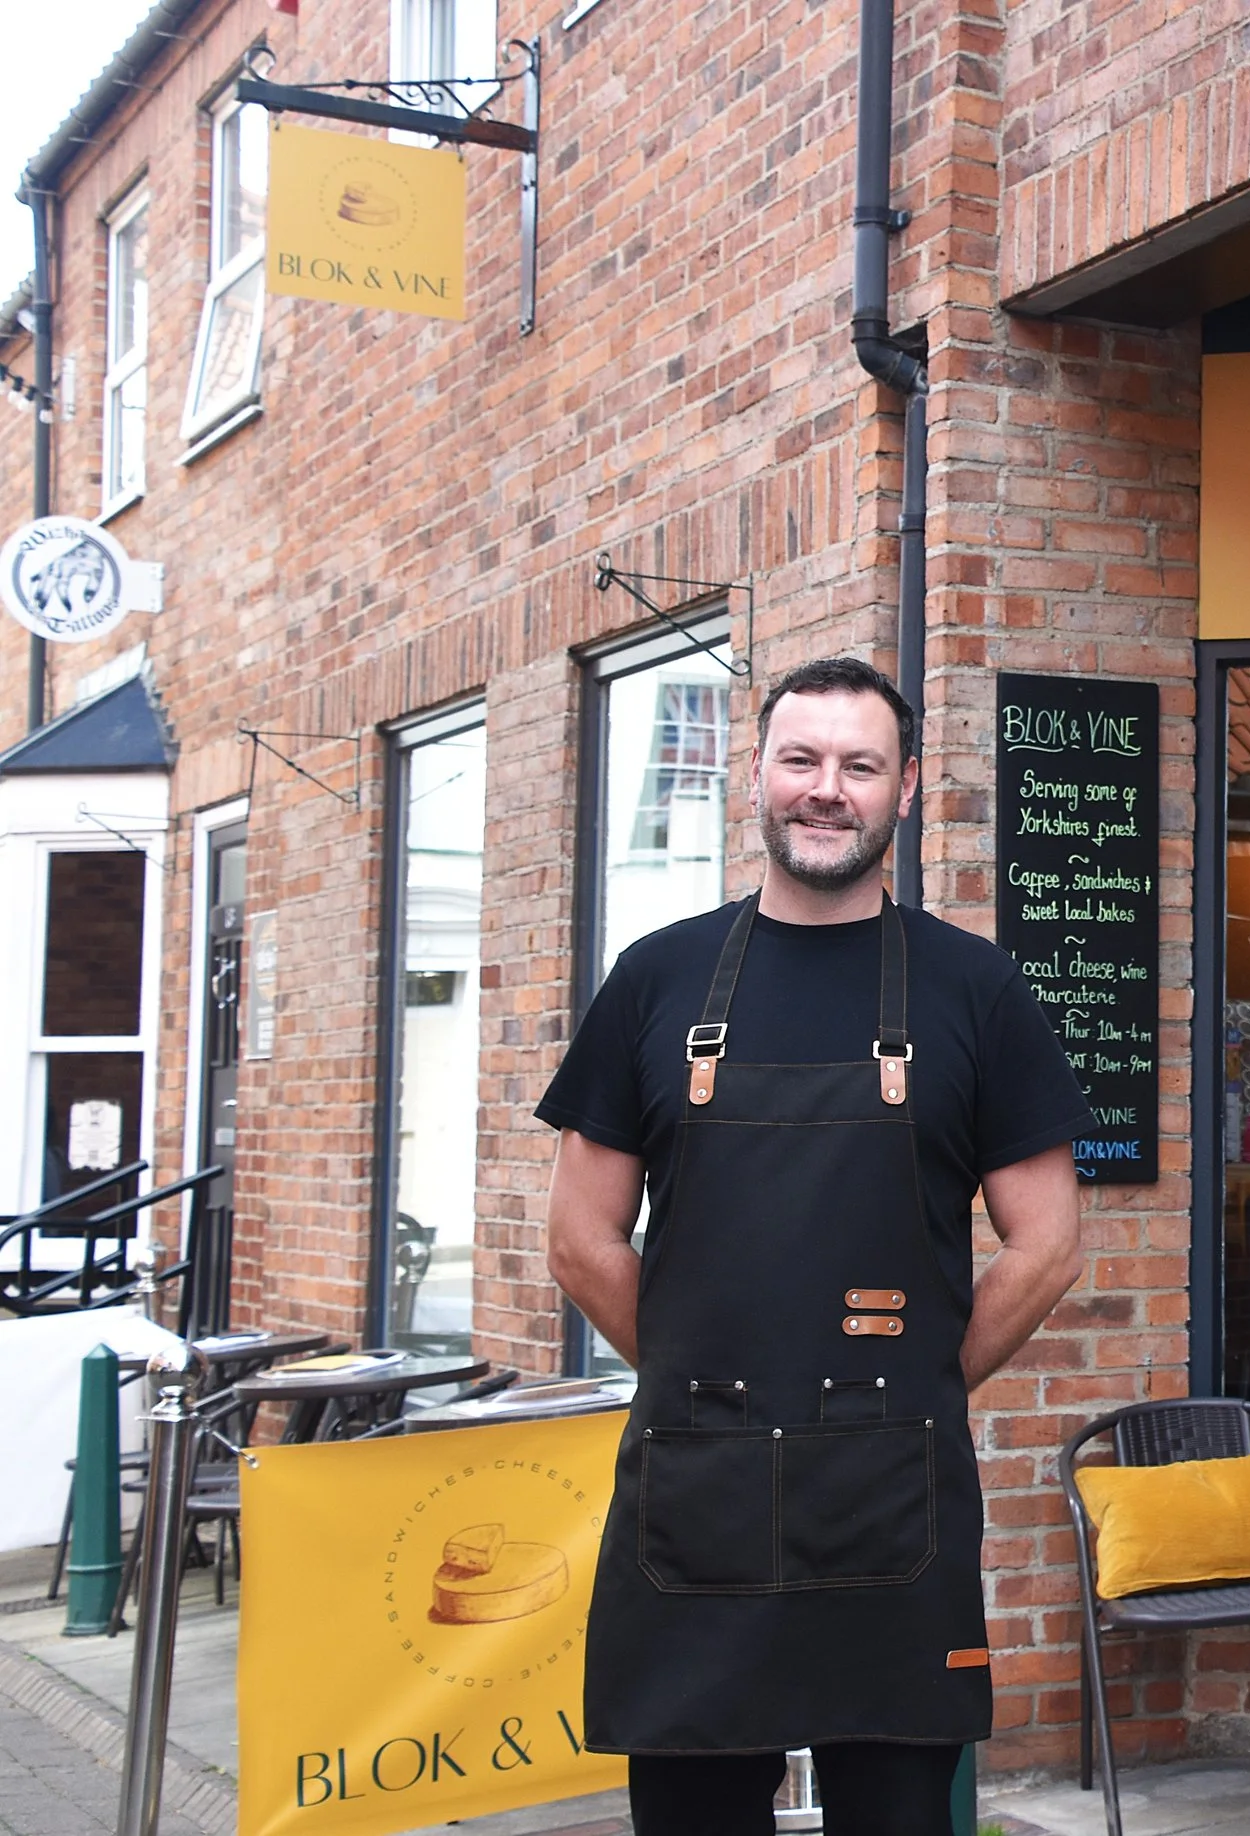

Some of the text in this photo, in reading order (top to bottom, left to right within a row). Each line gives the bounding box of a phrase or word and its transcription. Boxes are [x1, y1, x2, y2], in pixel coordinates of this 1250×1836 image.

[278, 252, 452, 300] BLOK & VINE
[1002, 705, 1142, 752] BLOK & VINE
[1019, 769, 1137, 812] Serving some of
[1016, 807, 1090, 836] Yorkshires
[1072, 865, 1141, 893] sandwiches
[1021, 897, 1136, 923] sweet local bakes
[1012, 950, 1148, 984] ocal cheese, wine
[1072, 1140, 1142, 1161] LOK&VINE
[494, 1459, 585, 1503] CHEESE
[385, 1466, 475, 1623] SANDWICHES
[401, 1638, 494, 1689] COFFEE
[296, 1727, 467, 1809] BLOK
[491, 1716, 534, 1772] &
